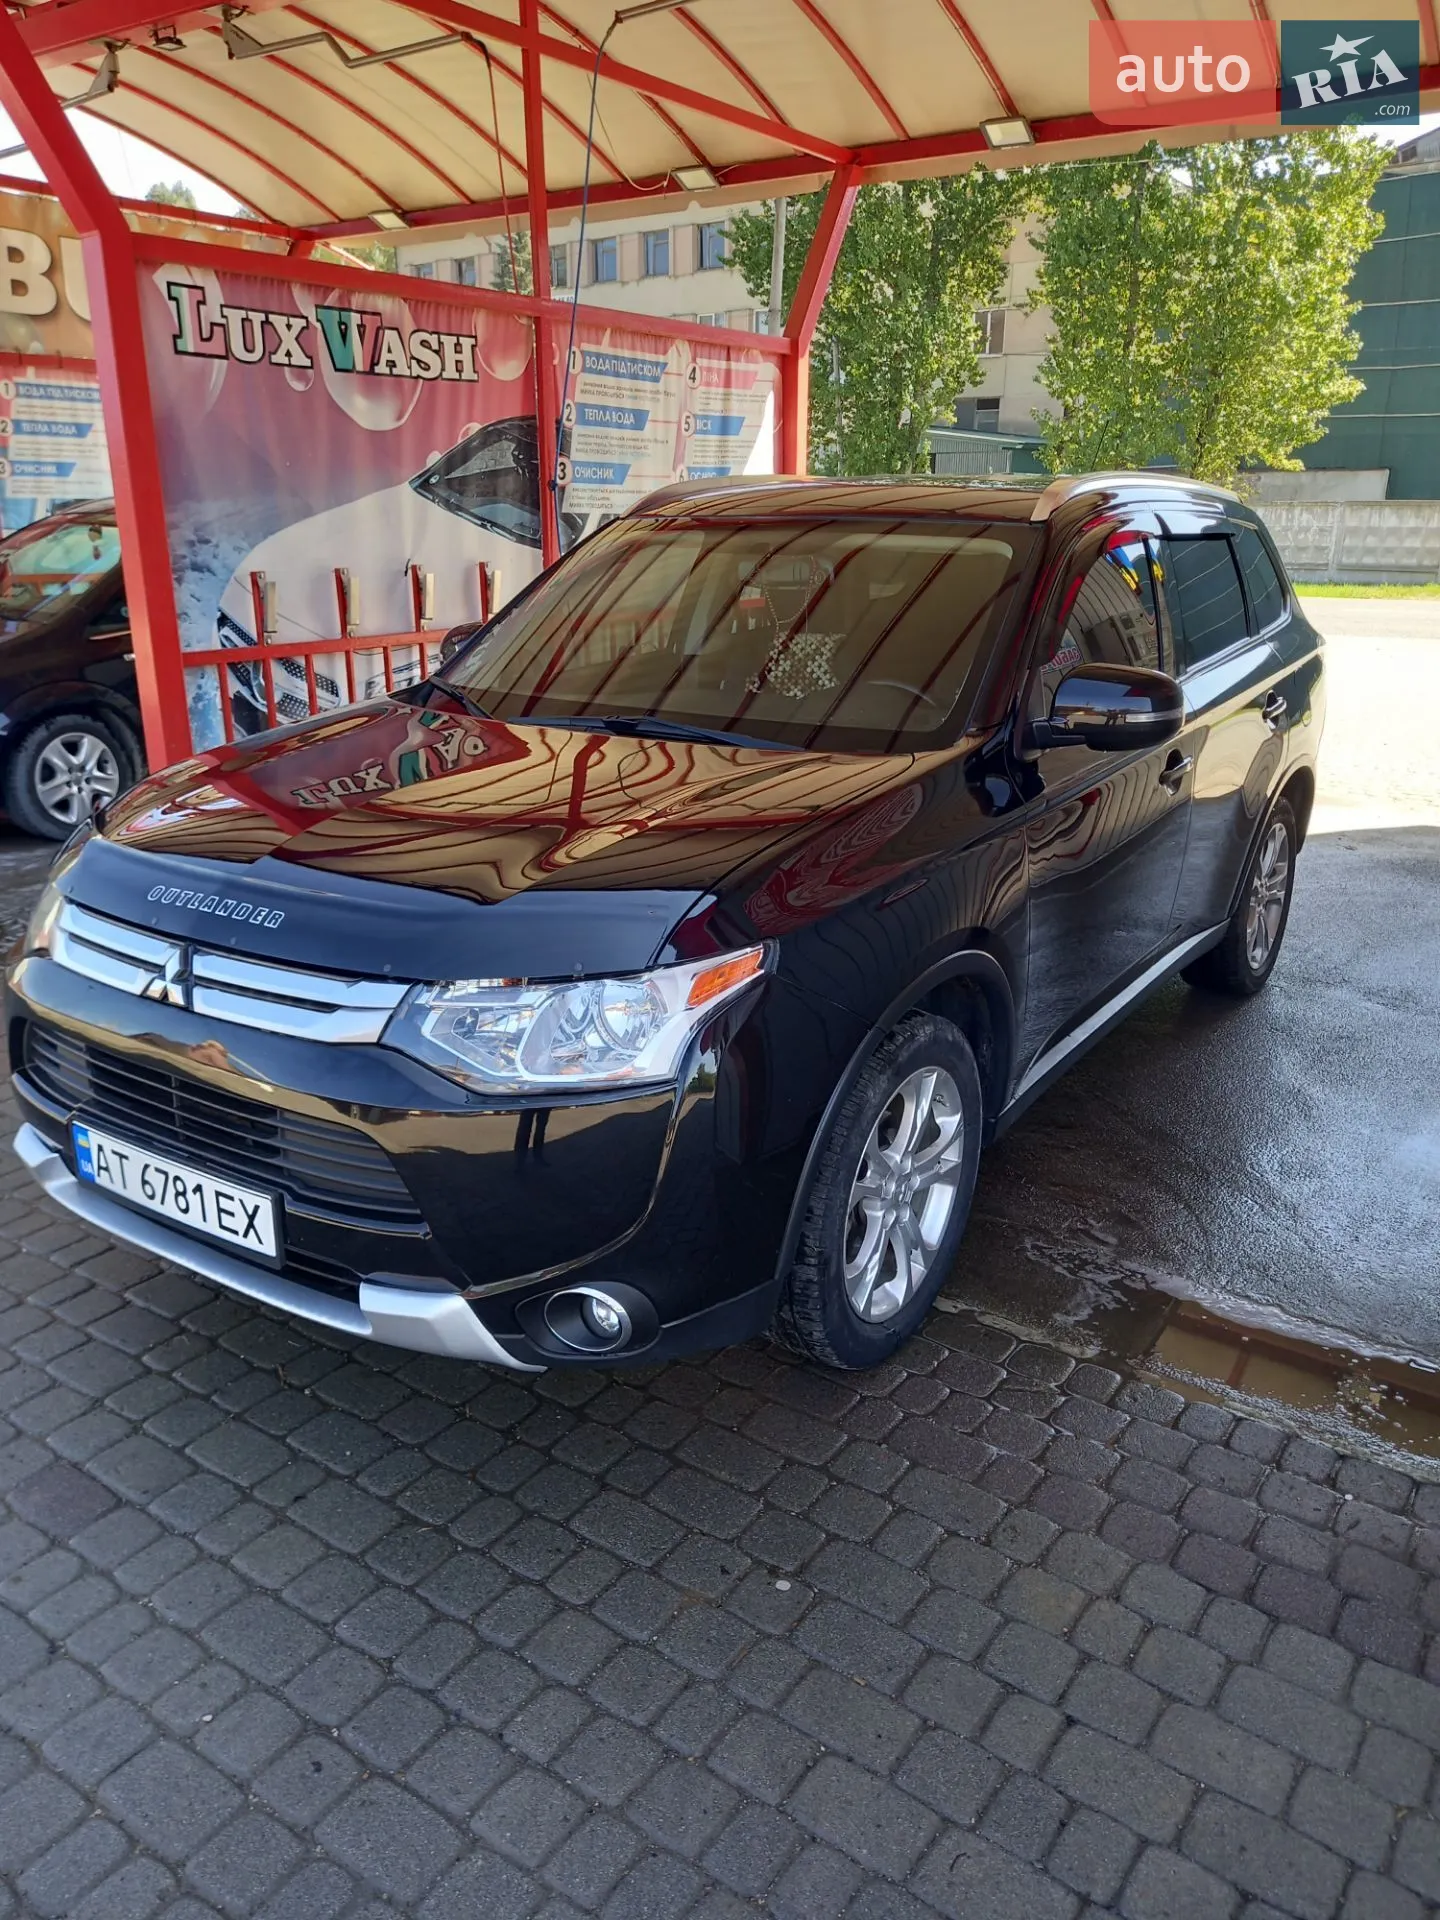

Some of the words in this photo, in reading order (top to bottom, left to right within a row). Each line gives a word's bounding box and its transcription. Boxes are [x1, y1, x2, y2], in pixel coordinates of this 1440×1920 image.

[585, 356, 610, 371] ВОДА
[611, 361, 626, 374] ПІД
[626, 362, 661, 377] ТИСКОМ
[688, 366, 697, 383] 4
[565, 404, 573, 422] 2
[584, 408, 611, 423] ТЕПЛА
[612, 411, 636, 425] ВОДА
[684, 416, 691, 432] 5
[558, 462, 567, 479] 3
[574, 466, 614, 479] ОЧИСНИК
[147, 885, 285, 929] OUTLANDER
[97, 1143, 129, 1190] AT
[141, 1163, 207, 1223] 6781
[215, 1190, 264, 1245] EX
